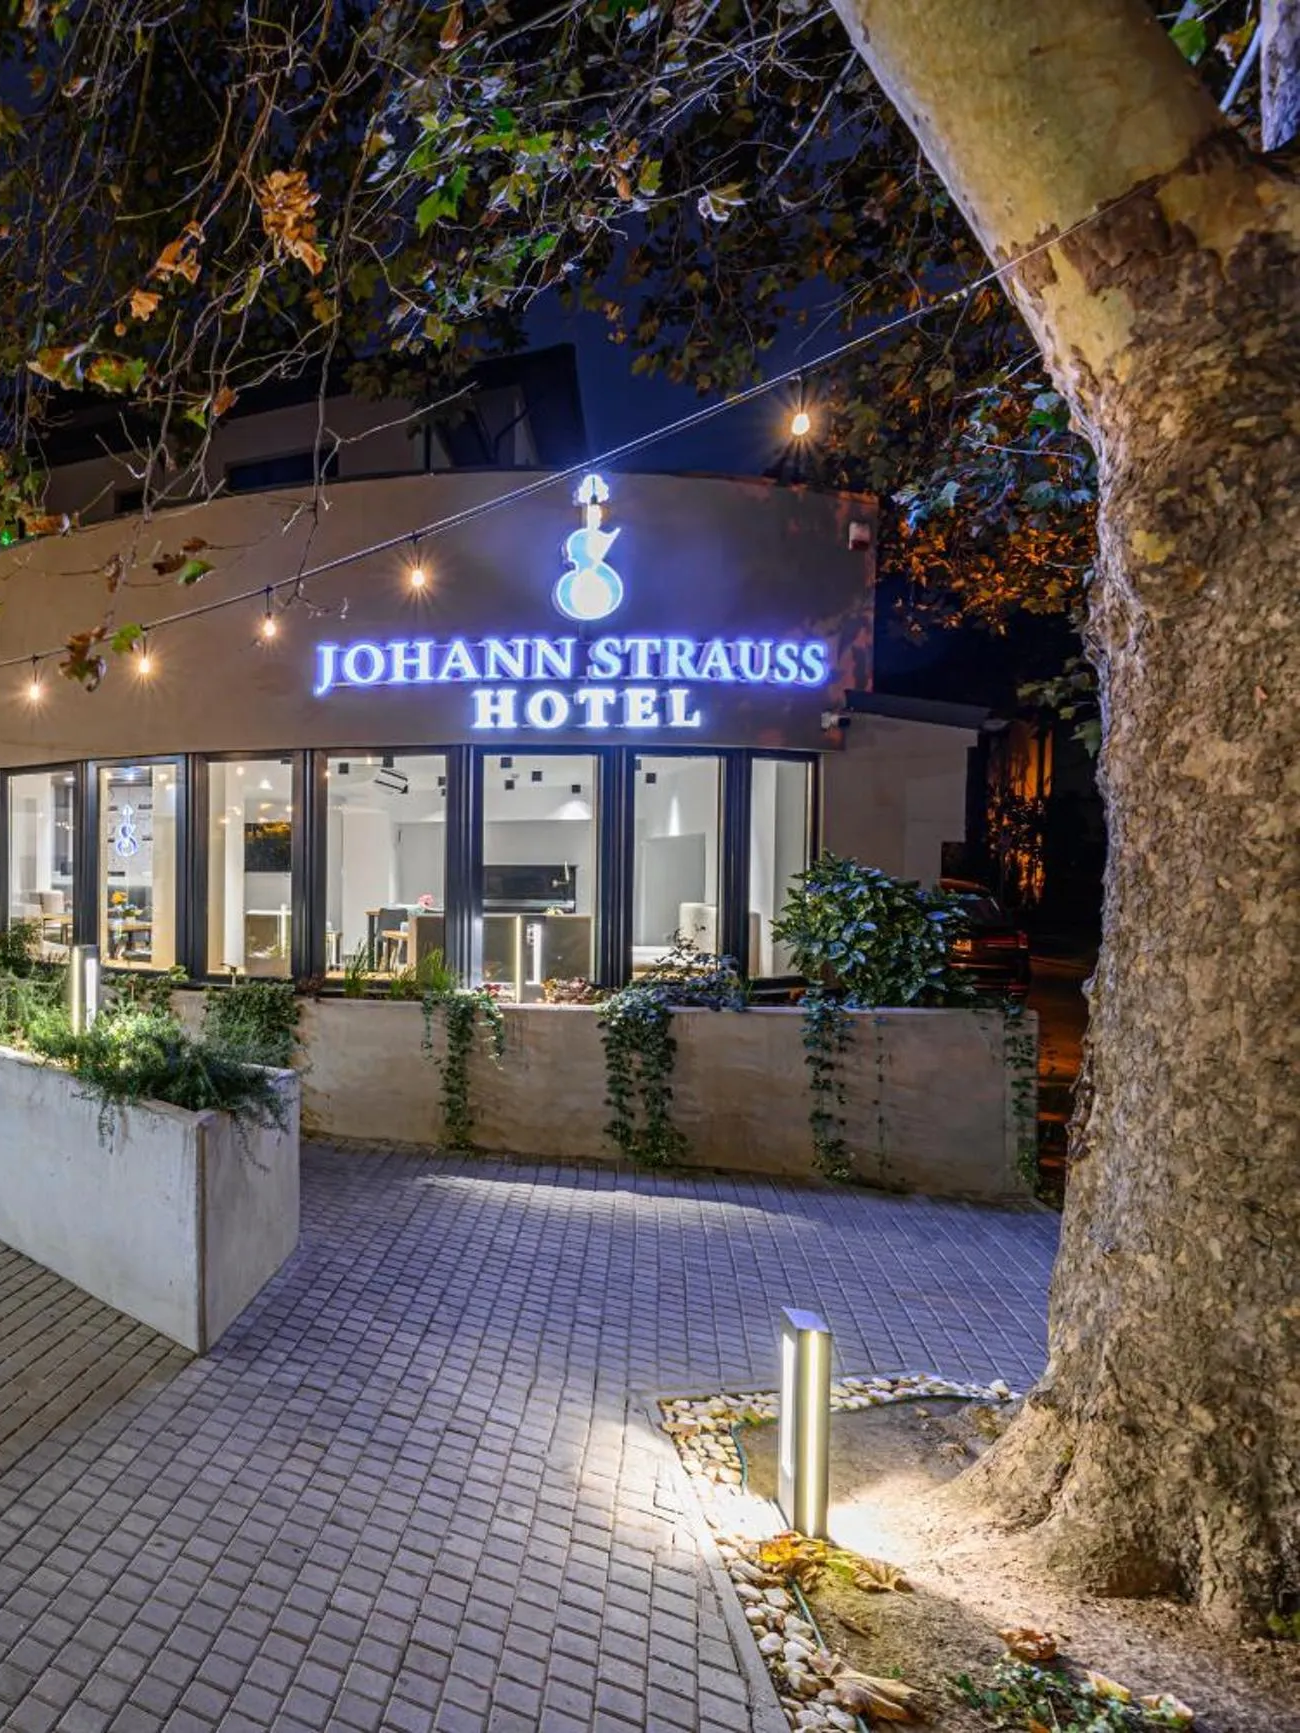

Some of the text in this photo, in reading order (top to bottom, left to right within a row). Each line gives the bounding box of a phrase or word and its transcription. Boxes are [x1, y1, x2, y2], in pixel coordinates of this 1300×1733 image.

[313, 637, 827, 697] JOHANN STRAUSS
[471, 688, 701, 729] HOTEL
